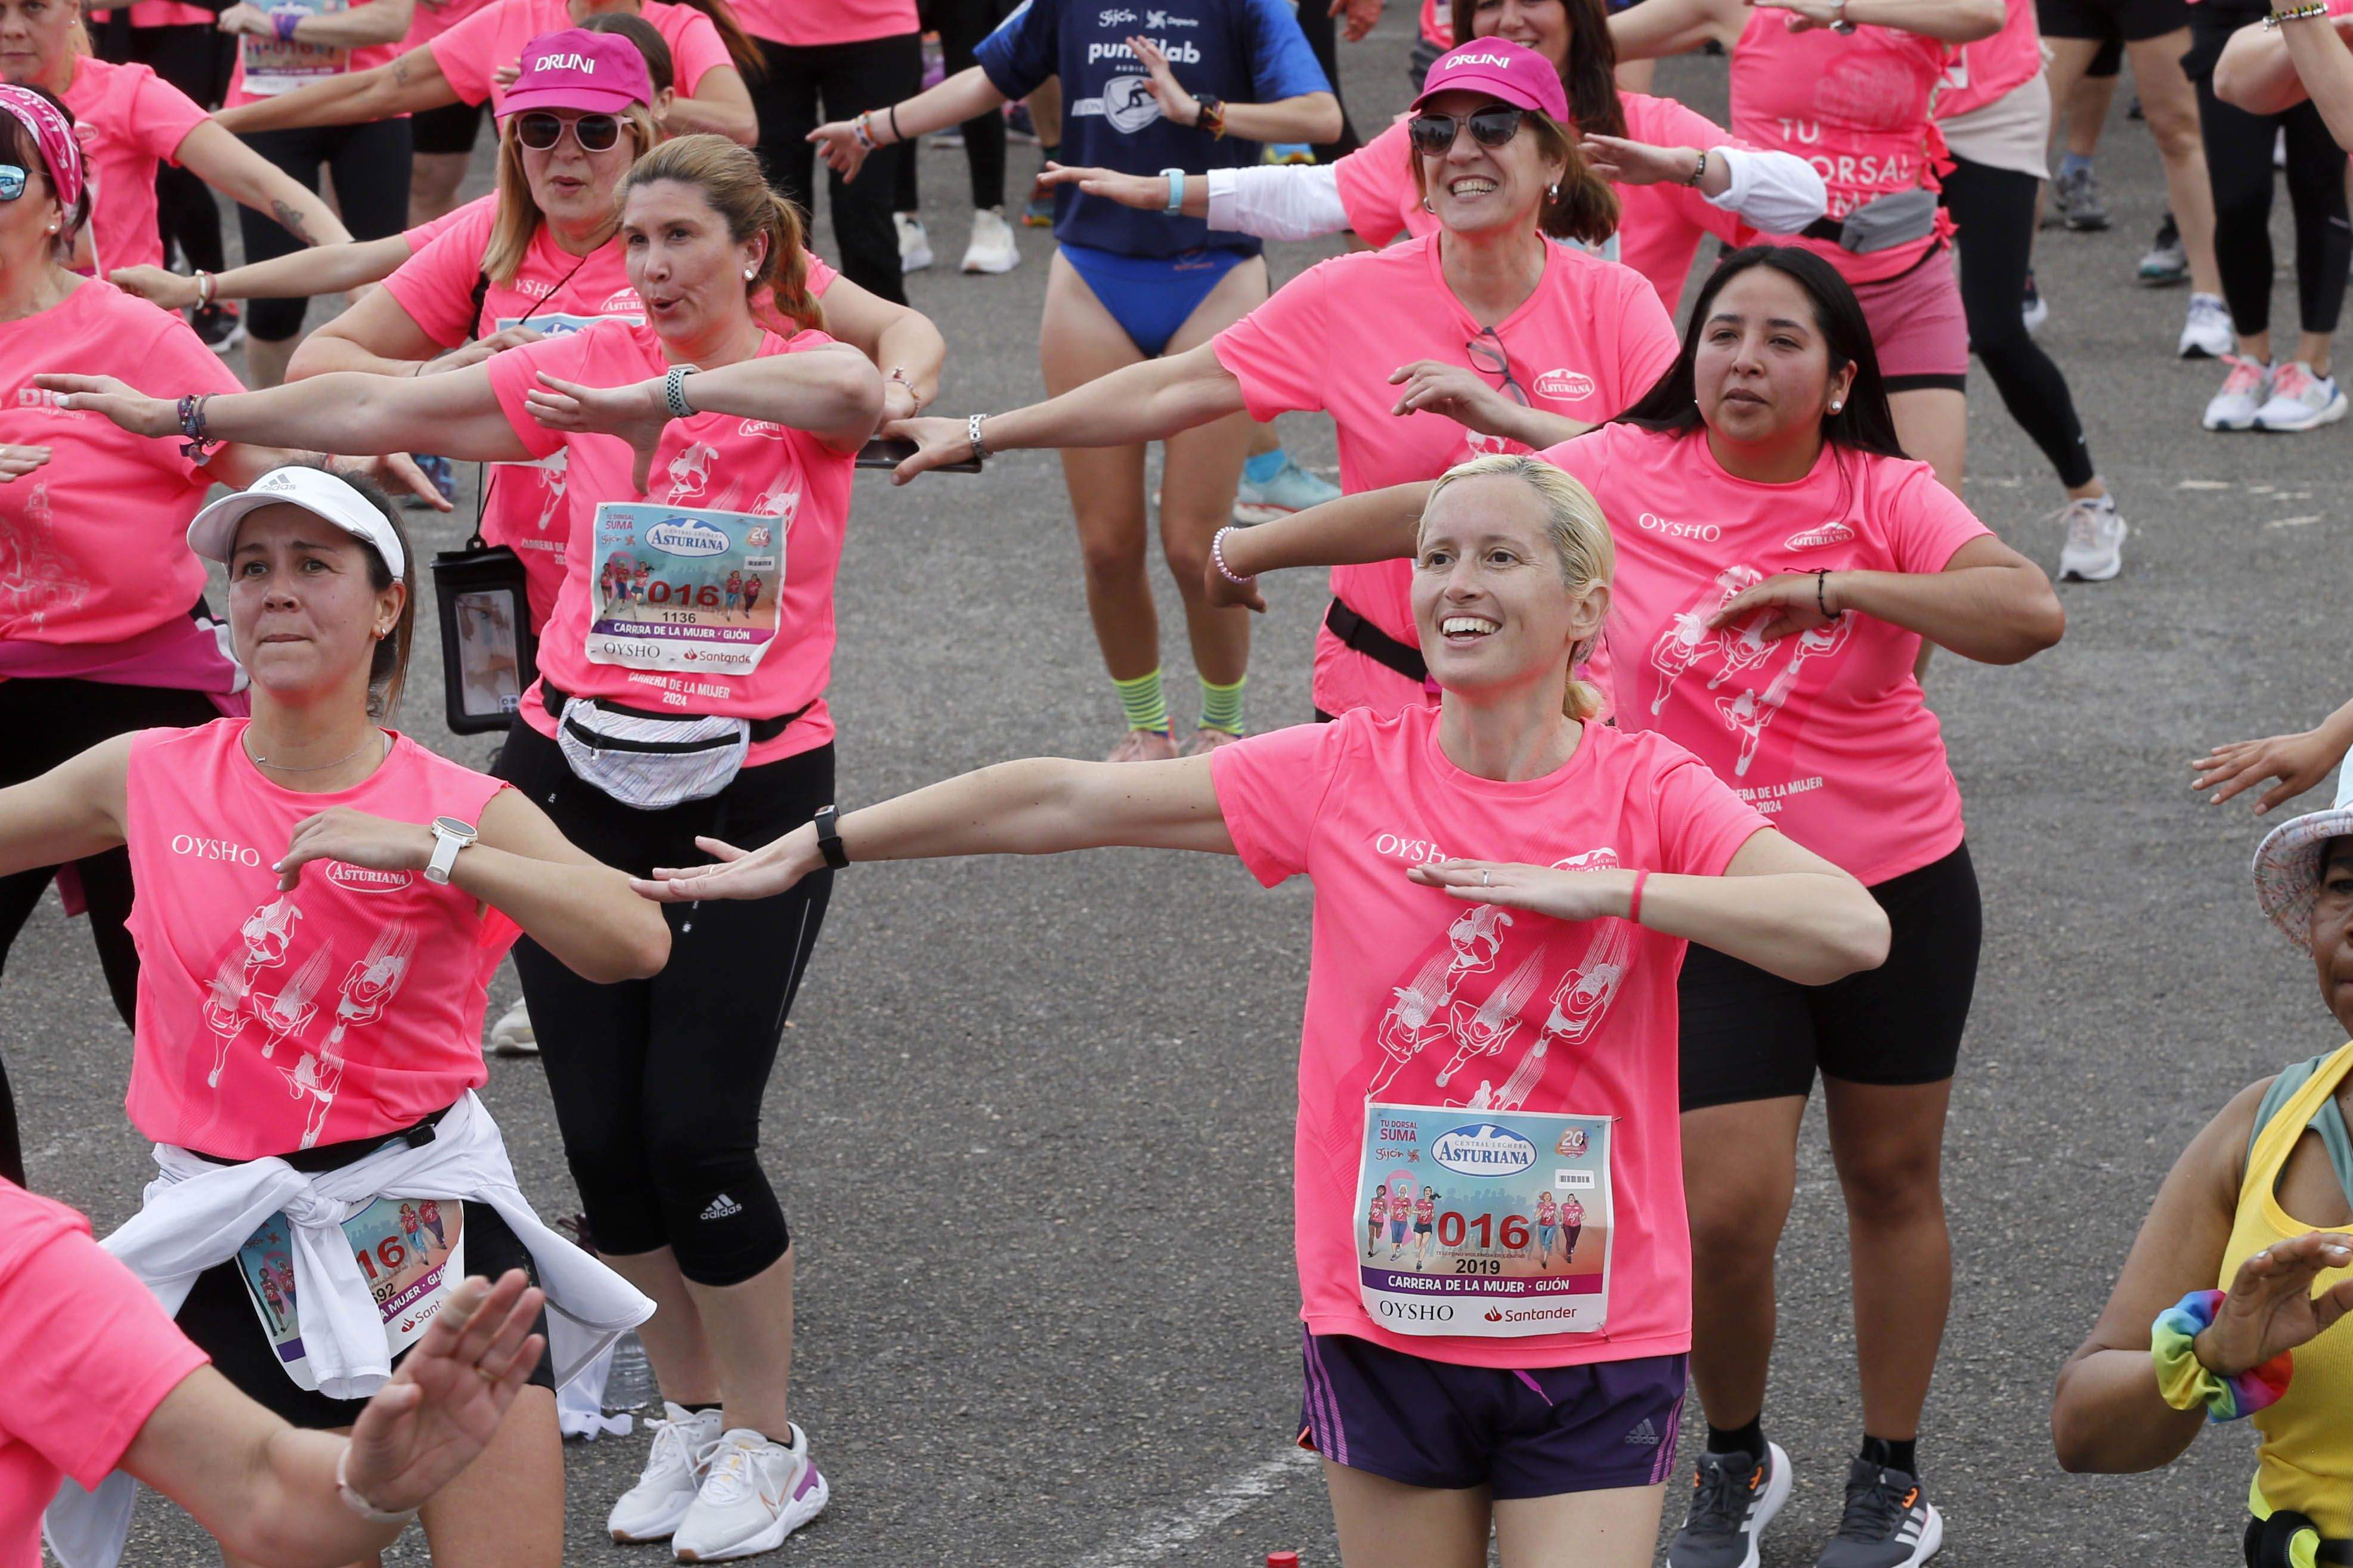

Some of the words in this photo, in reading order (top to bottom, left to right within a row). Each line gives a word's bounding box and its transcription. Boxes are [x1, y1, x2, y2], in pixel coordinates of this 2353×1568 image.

[534, 53, 595, 74] DRUNI
[1114, 64, 1148, 73] AUDIC
[1445, 54, 1510, 70] DRUNI
[1778, 118, 1819, 144] TU
[1808, 154, 1909, 185] ORSAL
[1540, 379, 1591, 393] ASTURIANA
[605, 520, 633, 529] SUMA
[751, 527, 768, 540] 20
[1639, 513, 1720, 542] OYSHO
[651, 529, 723, 551] ASTURIANA
[648, 581, 719, 606] 016
[662, 612, 696, 624] 1136
[654, 626, 666, 636] DE
[668, 627, 681, 637] LA
[683, 627, 716, 639] MUJER
[723, 628, 750, 640] GIJÓN
[604, 642, 660, 659] OYSHO
[628, 672, 667, 689] CARRERA
[668, 678, 682, 691] DE
[683, 681, 695, 695] LA
[697, 683, 731, 699] MUJER
[662, 692, 687, 706] 2024
[1758, 786, 1771, 800] DE
[1773, 784, 1787, 797] LA
[1788, 776, 1823, 795] MUJER
[1757, 800, 1782, 814] 2024
[172, 834, 260, 867] OYSHO
[1376, 833, 1462, 864] OYSH
[332, 864, 405, 884] ASTURIANA
[1380, 1128, 1417, 1142] SUMA
[1561, 1130, 1584, 1147] 20
[1438, 1141, 1529, 1165] ASTURIANA
[701, 1203, 742, 1219] adidas
[1438, 1211, 1530, 1250] 016
[357, 1235, 405, 1279] 16
[1456, 1259, 1501, 1275] 2019
[1388, 1275, 1442, 1291] CARRERA
[1445, 1279, 1461, 1291] DE
[1465, 1279, 1480, 1291] LA
[1484, 1279, 1525, 1293] MUJER
[1535, 1276, 1569, 1291] GIJÓN
[388, 1286, 421, 1313] MUJER
[415, 1300, 441, 1324] Sant
[1379, 1300, 1454, 1322] OYSHO
[1504, 1306, 1577, 1322] Santander
[1625, 1434, 1660, 1445] adidas
